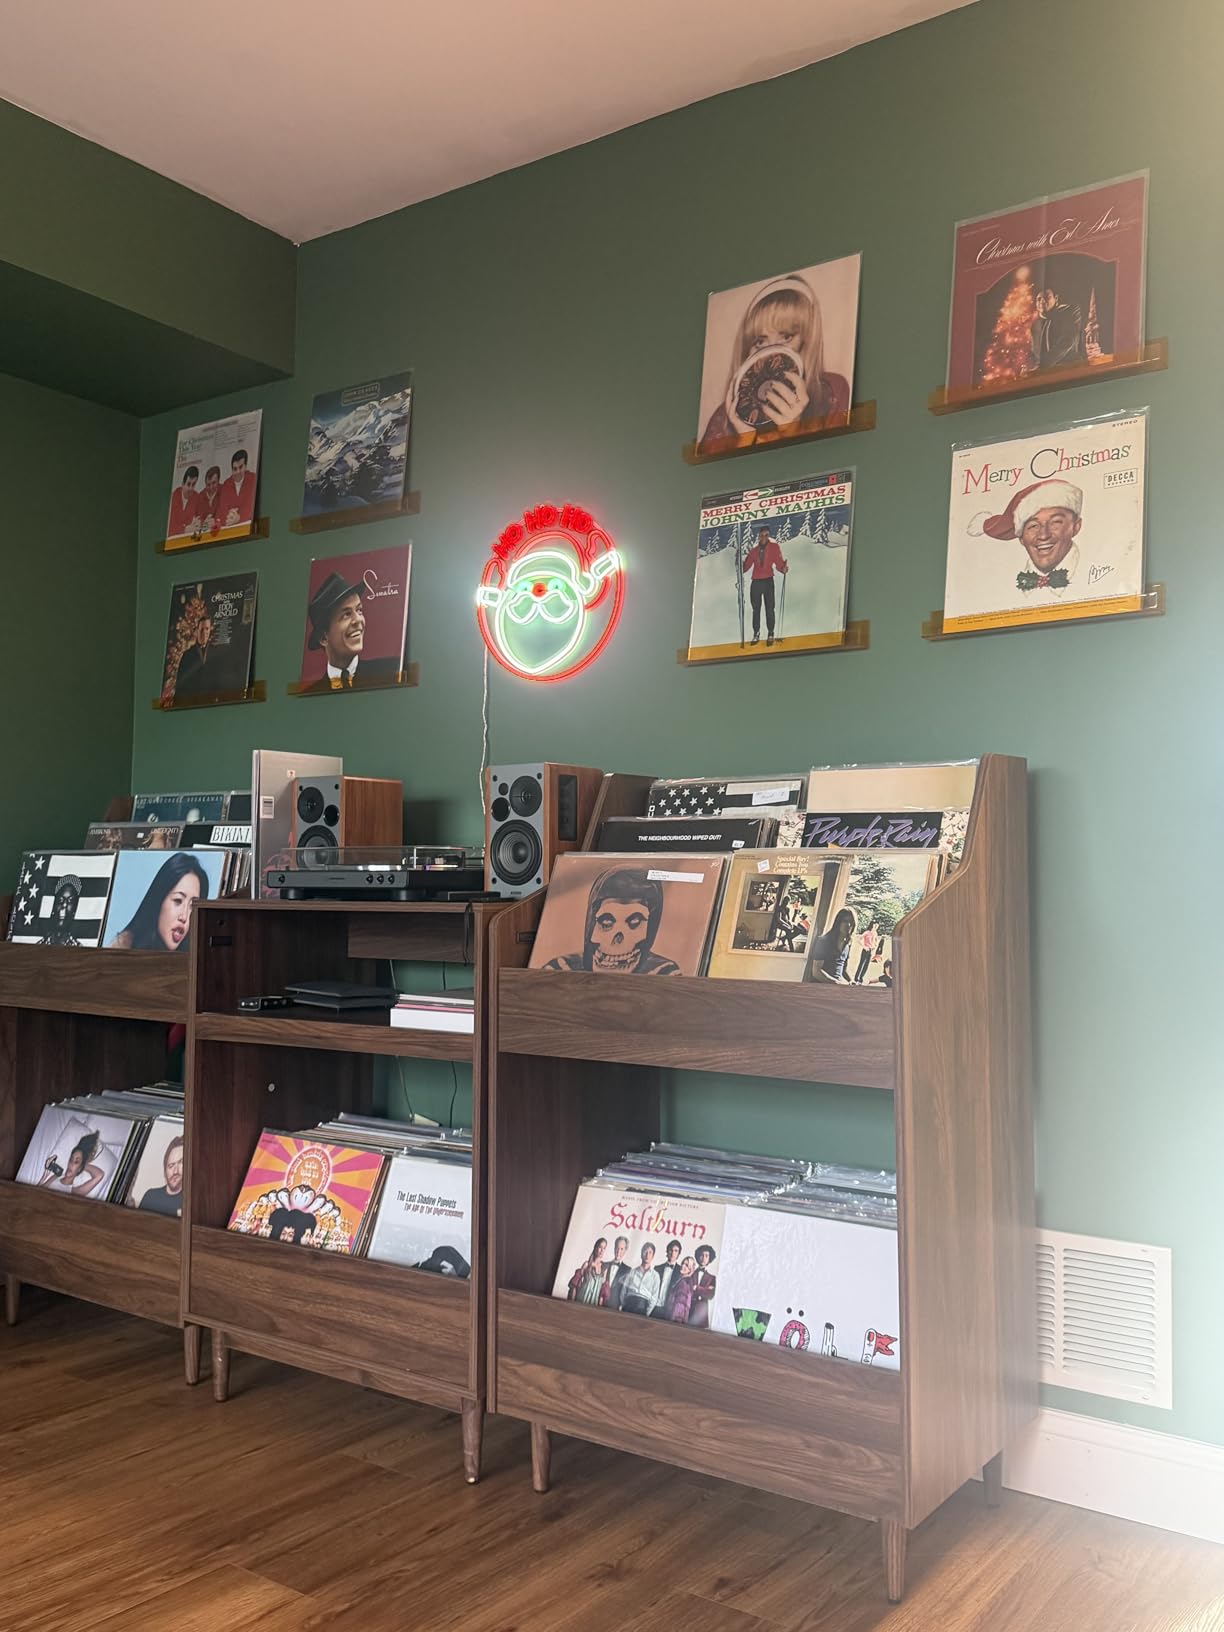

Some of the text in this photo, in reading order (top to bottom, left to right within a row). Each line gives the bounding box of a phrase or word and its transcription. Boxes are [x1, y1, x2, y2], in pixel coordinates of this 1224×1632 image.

[976, 206, 1120, 264] Christmas with Ed Ames
[962, 445, 1131, 495] Merry Christmas
[1108, 473, 1134, 483] DECCA
[702, 485, 846, 519] MERRY CHRISTMAS
[702, 495, 845, 529] JOHNNY MATHIS
[491, 504, 593, 560] HO HO HO
[211, 591, 243, 603] CHRISTMAS
[363, 569, 399, 600] Sinatra
[214, 608, 239, 618] ARNOLD
[219, 602, 234, 612] EDDY
[805, 815, 938, 848] Purple Rain
[777, 855, 810, 863] Special Buy!
[397, 1190, 457, 1209] The Last Shadow Puppets
[603, 1202, 706, 1240] Saltburn
